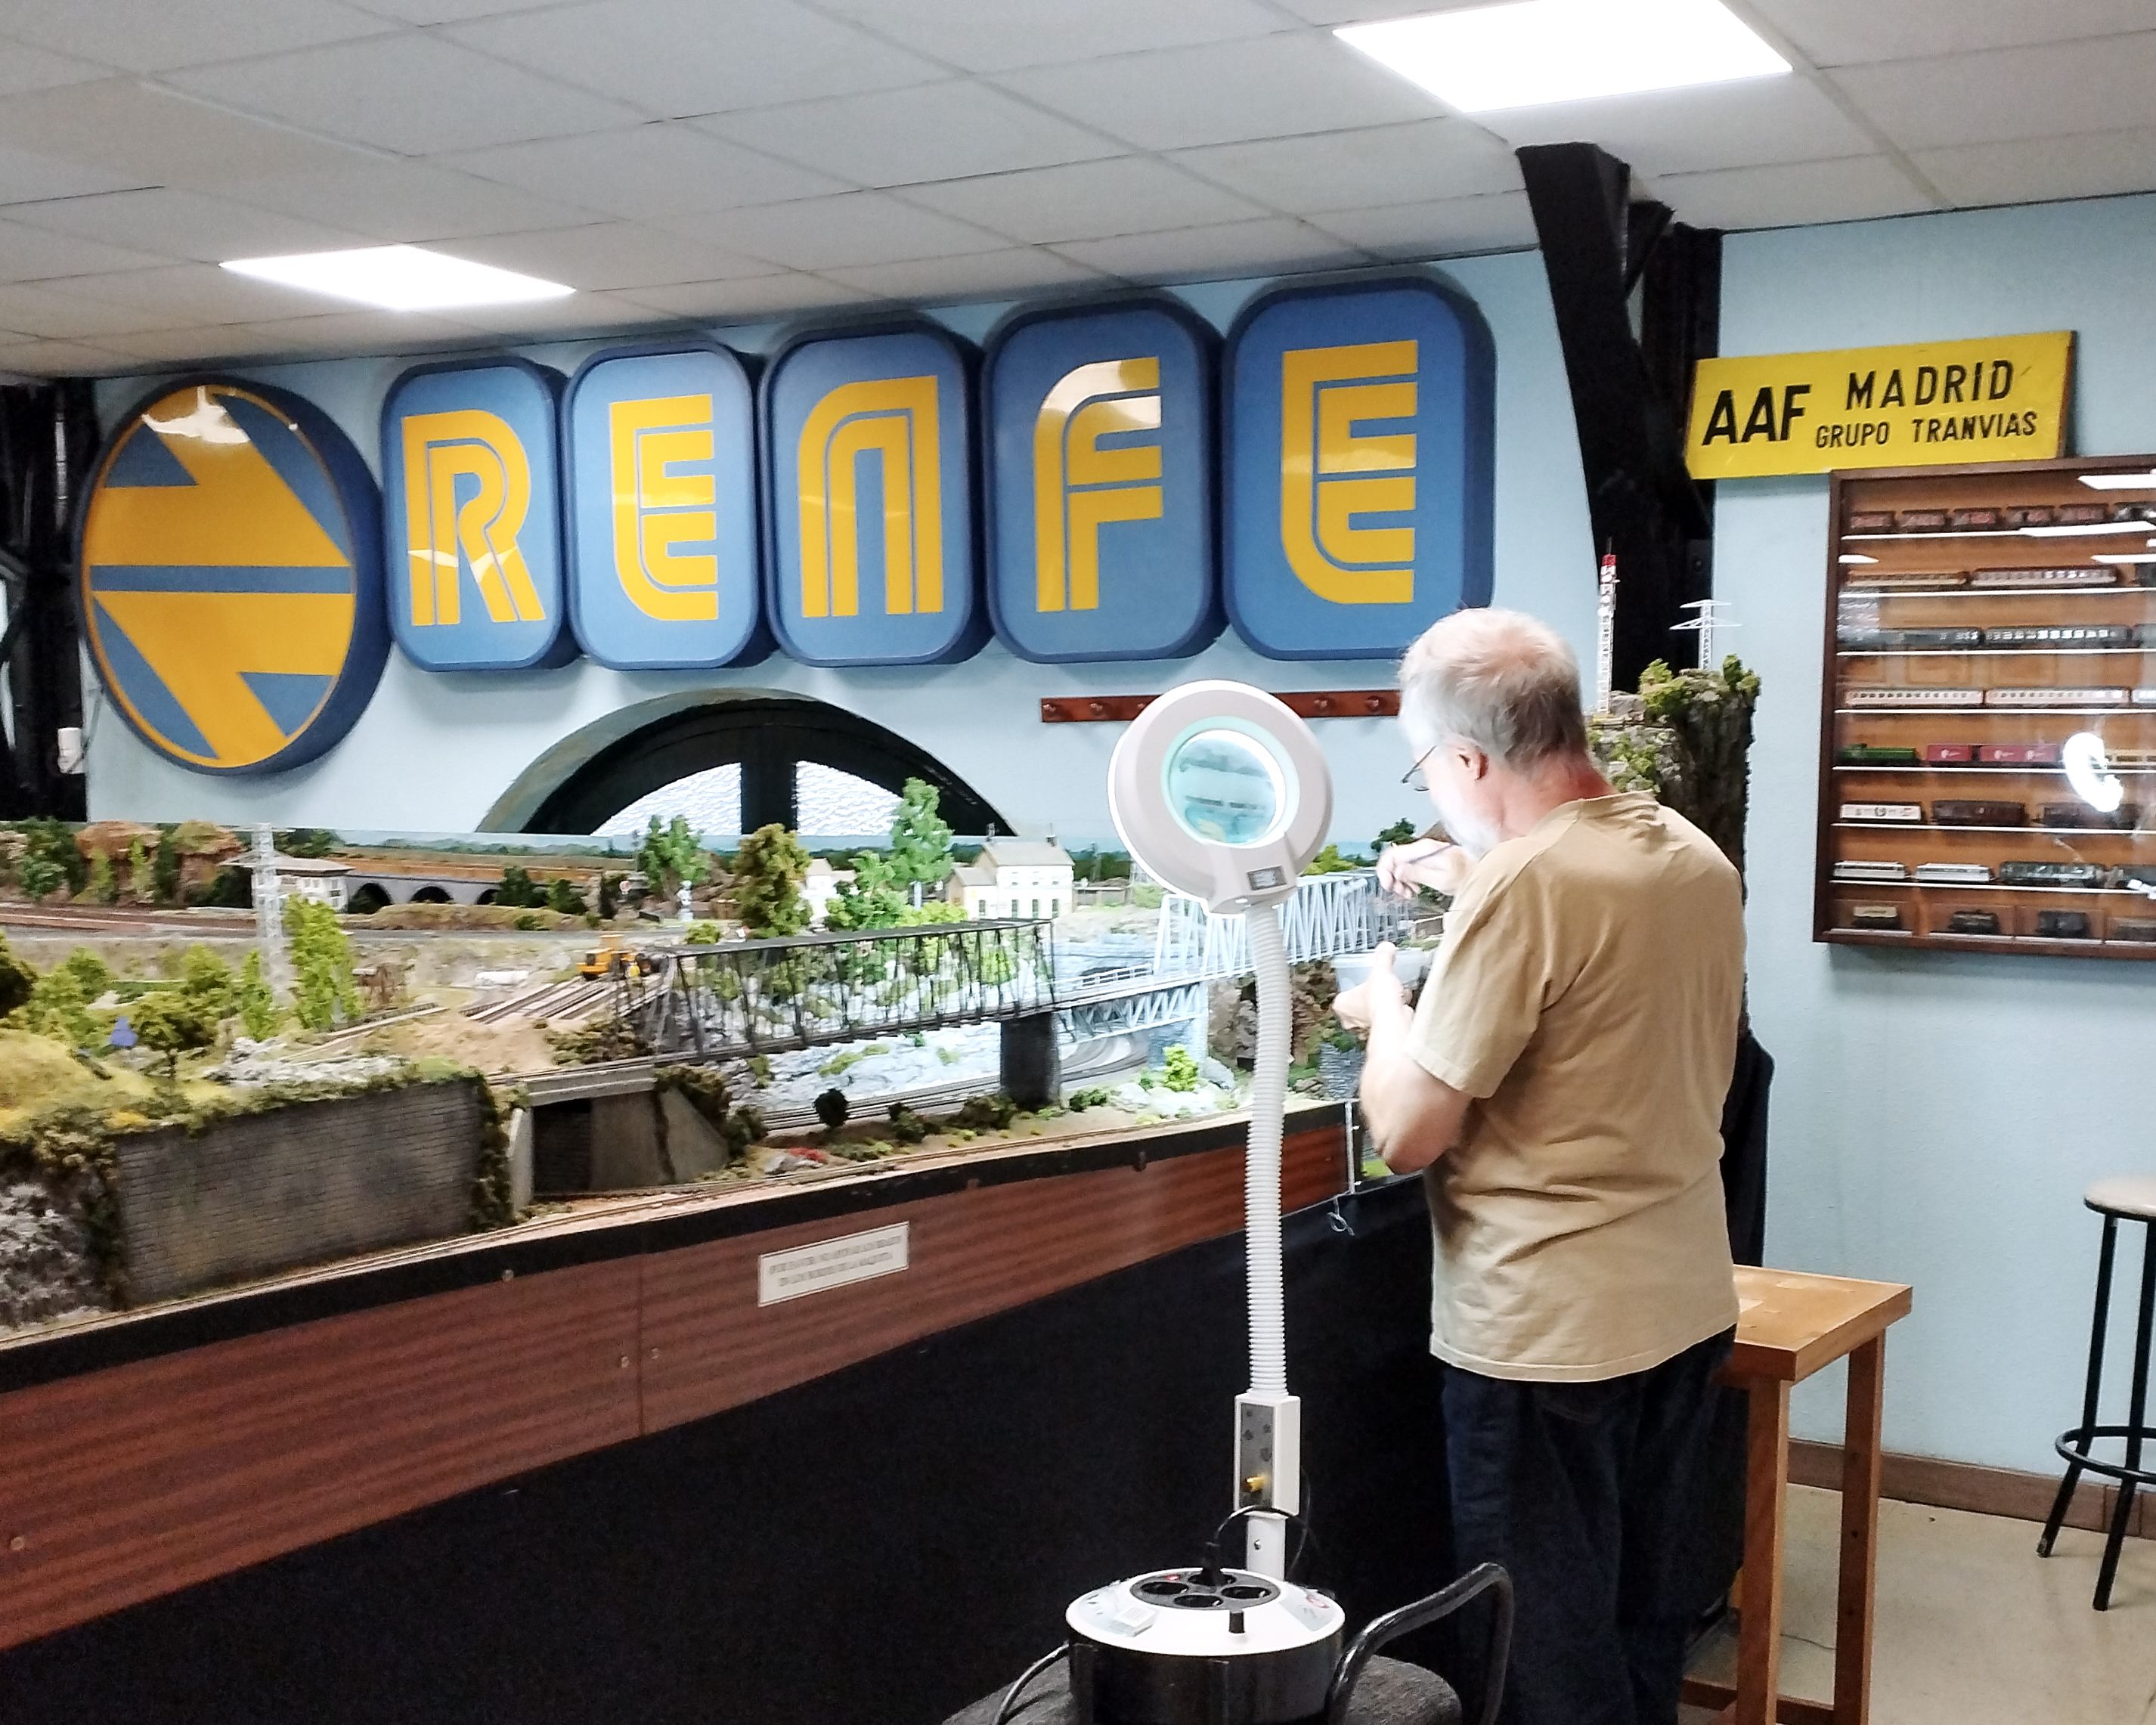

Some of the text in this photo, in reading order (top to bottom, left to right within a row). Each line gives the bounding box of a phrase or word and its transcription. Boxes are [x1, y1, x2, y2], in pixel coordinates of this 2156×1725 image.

[1845, 359, 2014, 410] MADRID
[1702, 384, 1811, 446] AAF
[1815, 410, 2037, 448] GRUPO TRANVIAS
[401, 340, 1417, 626] RENFE
